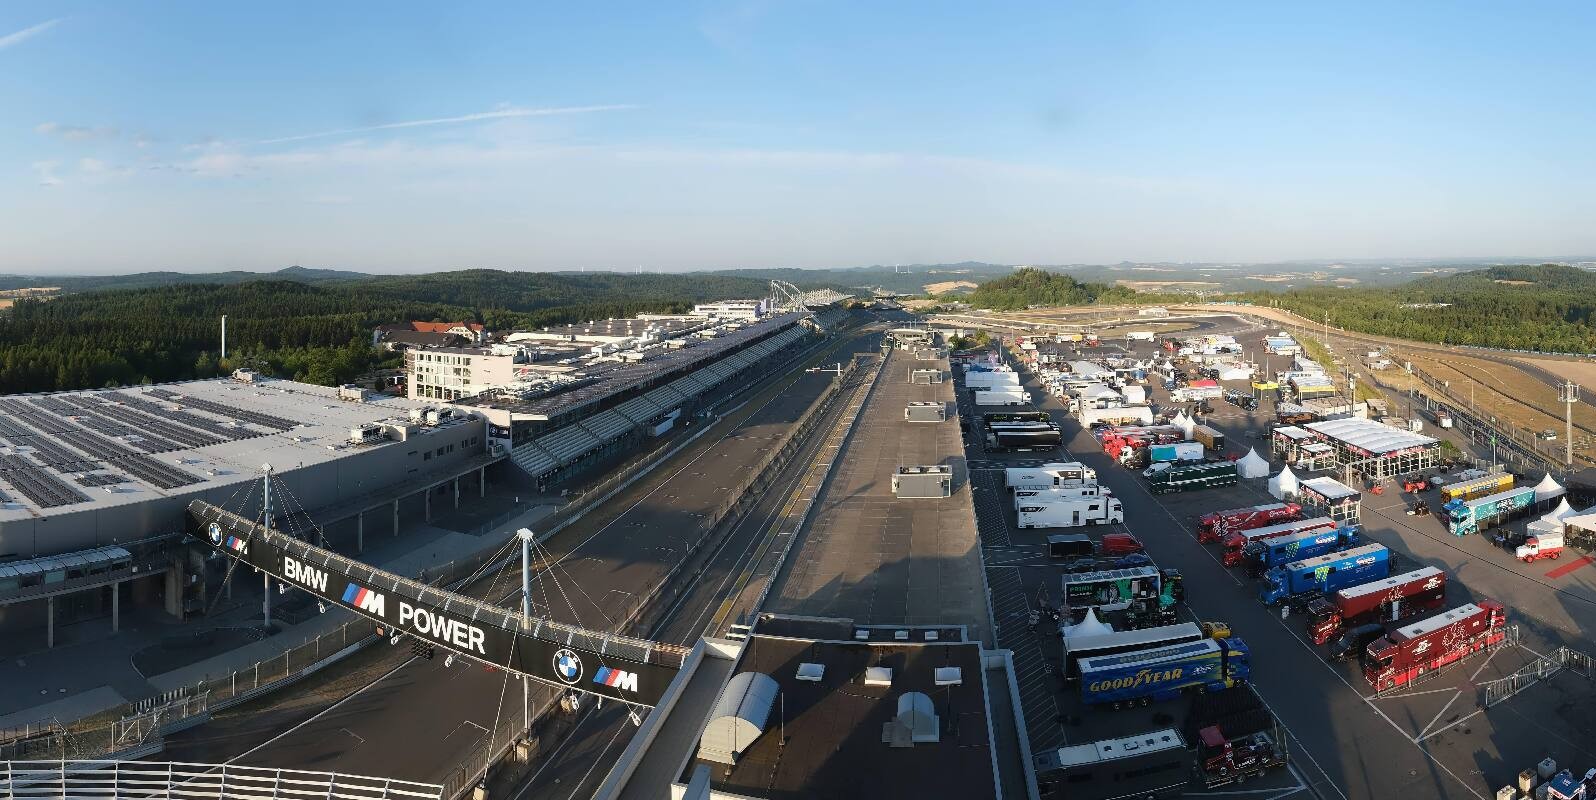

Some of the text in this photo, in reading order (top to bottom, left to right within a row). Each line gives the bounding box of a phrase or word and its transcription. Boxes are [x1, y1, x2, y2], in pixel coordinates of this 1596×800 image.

[284, 557, 328, 593] BMW
[399, 601, 486, 655] POWER
[1089, 668, 1184, 692] GOODYEAR
